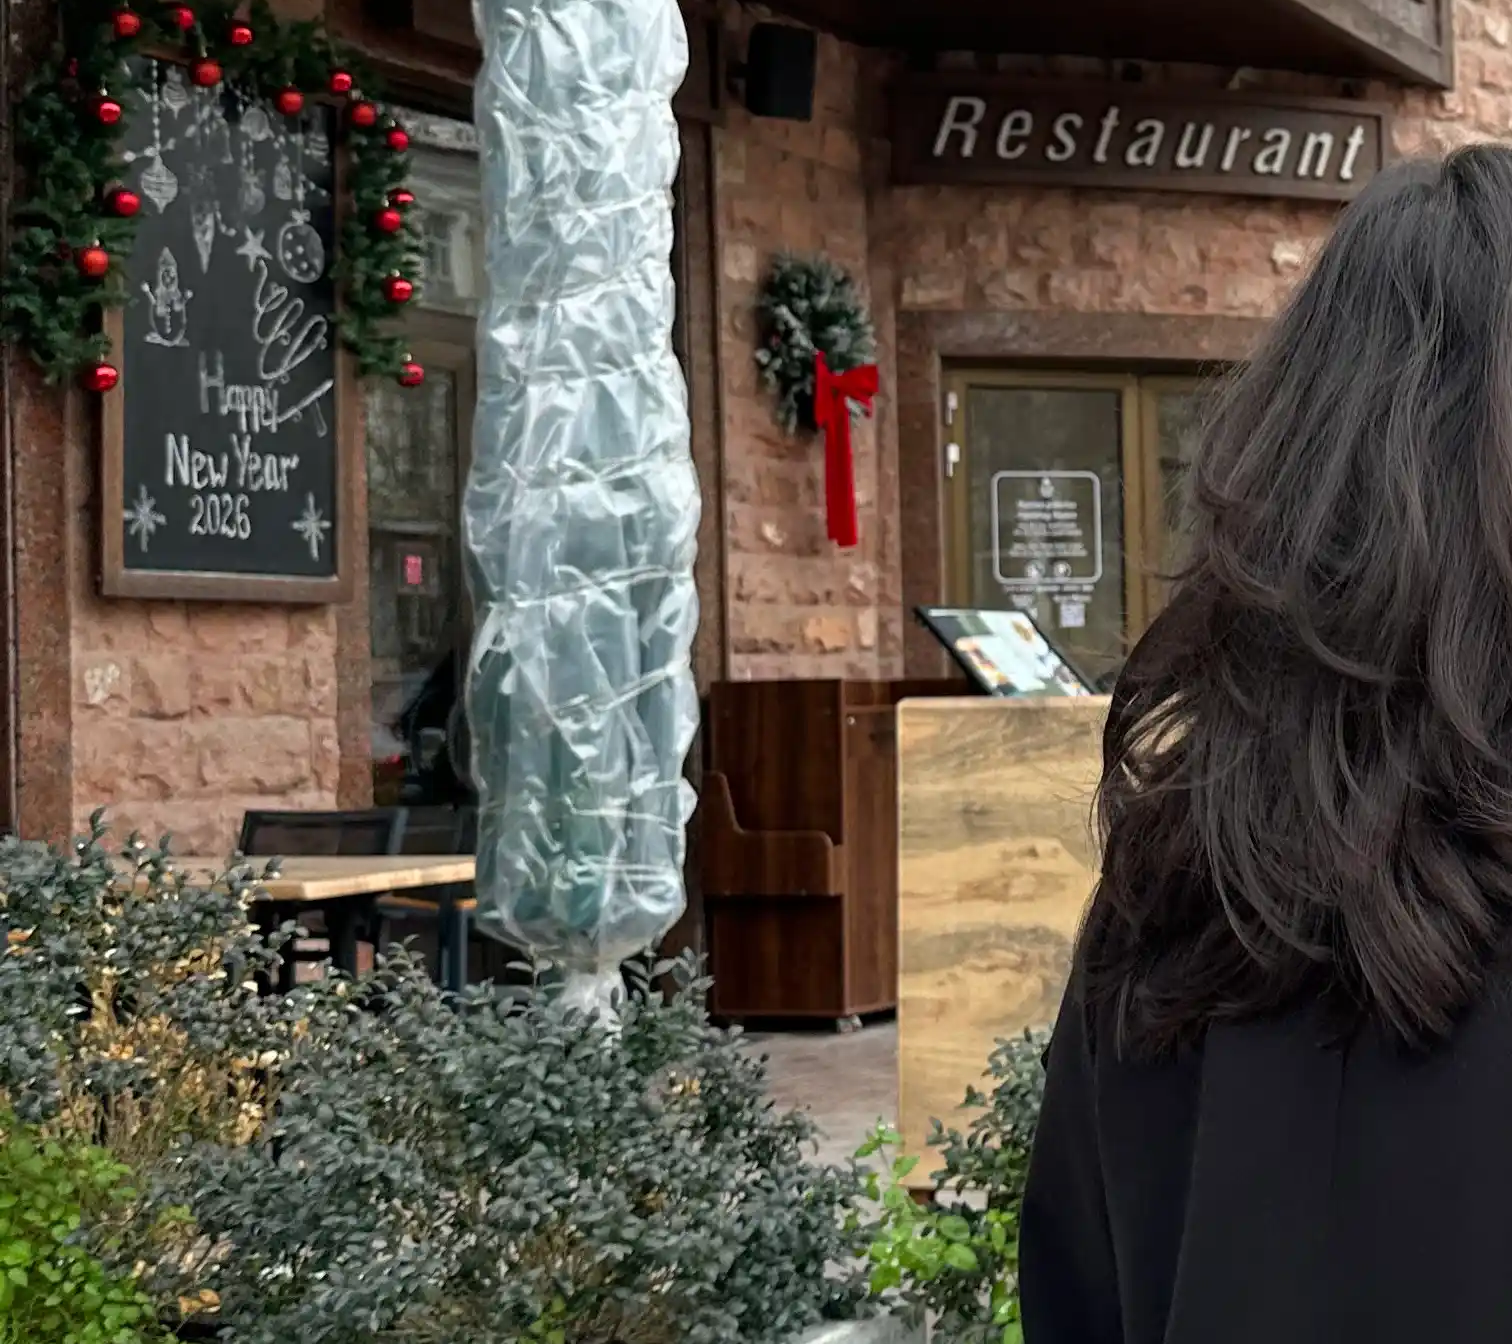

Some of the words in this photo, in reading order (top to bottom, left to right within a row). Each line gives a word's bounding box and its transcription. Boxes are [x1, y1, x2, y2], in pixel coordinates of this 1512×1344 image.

[932, 95, 1366, 181] Restaurant
[199, 350, 281, 434] Happy
[164, 432, 230, 490] New
[229, 433, 300, 493] Year
[188, 492, 252, 541] 2026
